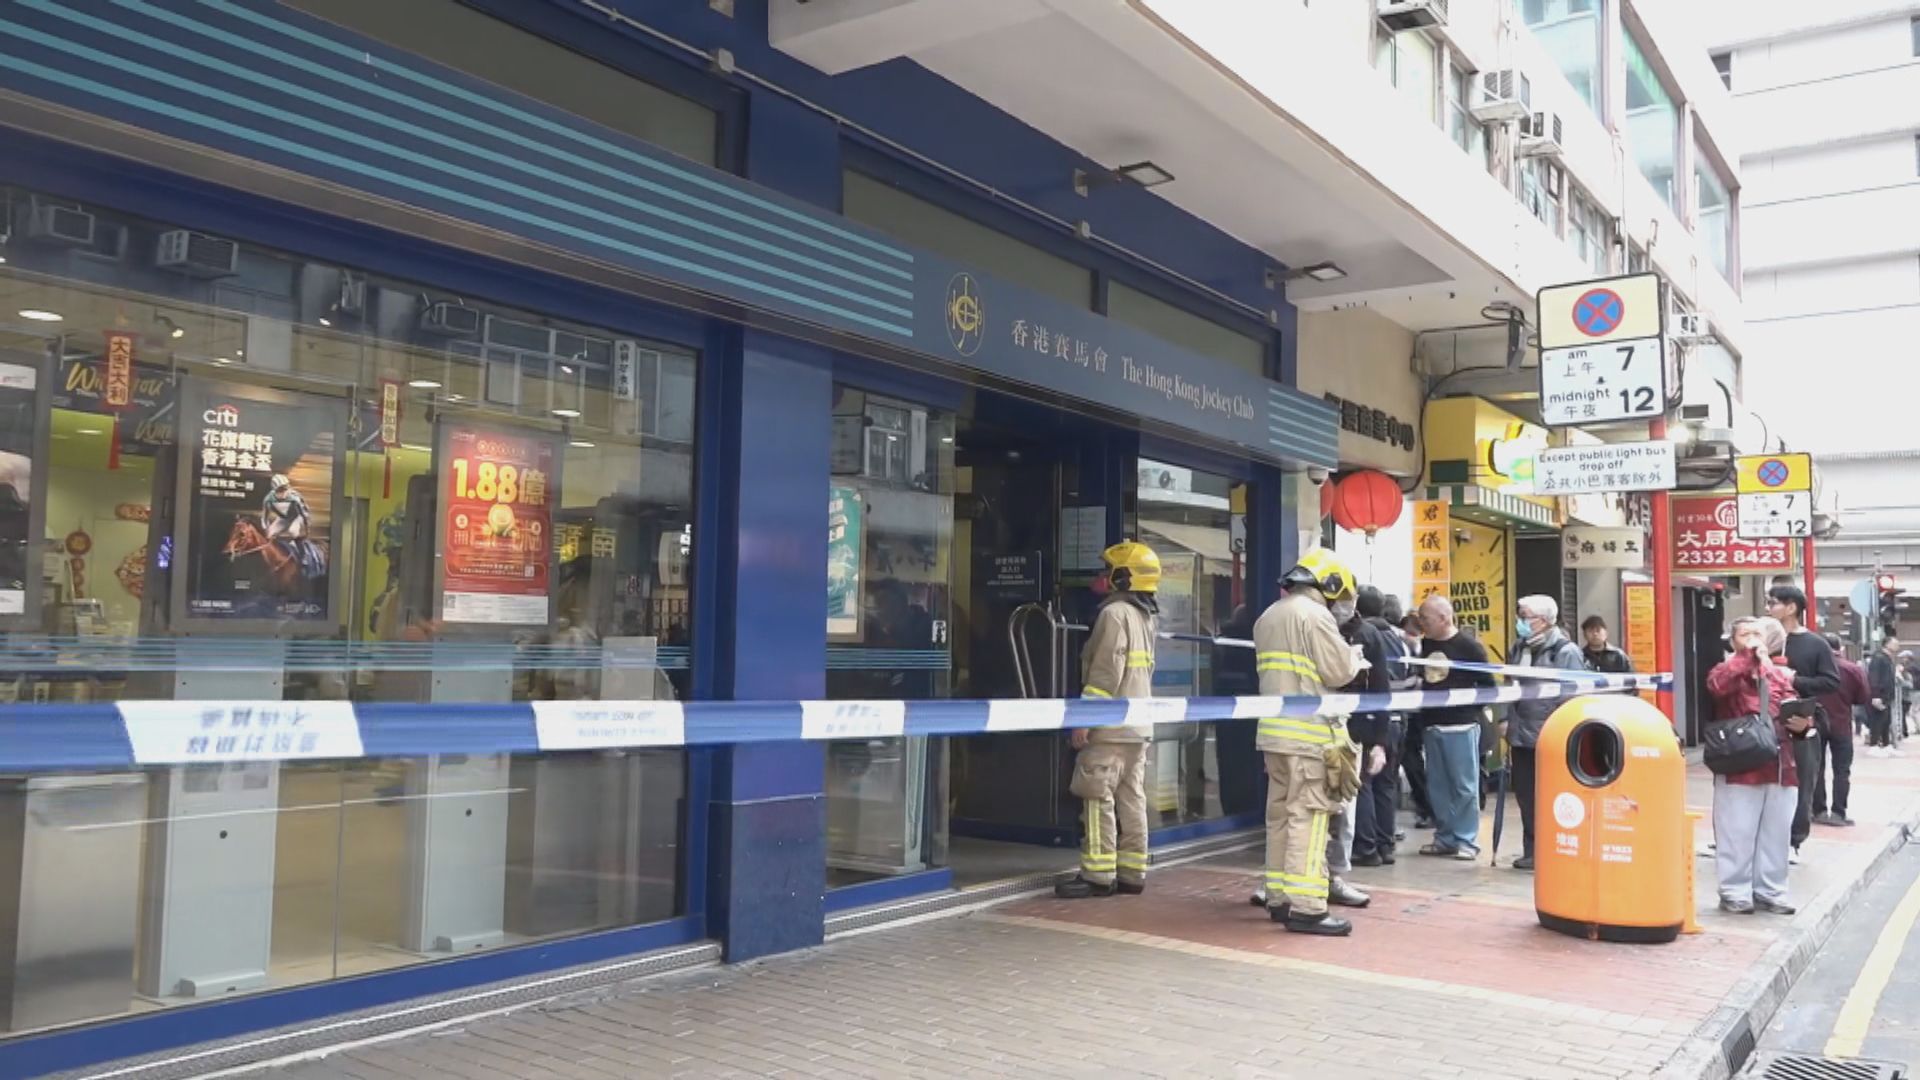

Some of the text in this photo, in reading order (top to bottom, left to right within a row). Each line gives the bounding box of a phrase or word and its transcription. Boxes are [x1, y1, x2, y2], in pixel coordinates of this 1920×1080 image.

[1011, 319, 1108, 373] 香港賽馬會
[1568, 350, 1588, 360] am
[1616, 346, 1635, 371] 7
[108, 337, 129, 403] 大吉大利
[1563, 361, 1596, 377] 上午
[1121, 355, 1255, 420] The Hong Kong Jockey Club
[1549, 387, 1611, 404] midnight
[1619, 386, 1655, 413] 12
[1564, 404, 1597, 419] 午夜
[202, 428, 273, 453] 花旗銀行
[1538, 447, 1667, 464] Except public light bus
[1579, 460, 1624, 471] drop off
[1543, 471, 1662, 490] 公共小巴落客除外
[1783, 494, 1795, 510] 7
[1786, 518, 1807, 535] 12
[1676, 550, 1786, 564] 2332 8423
